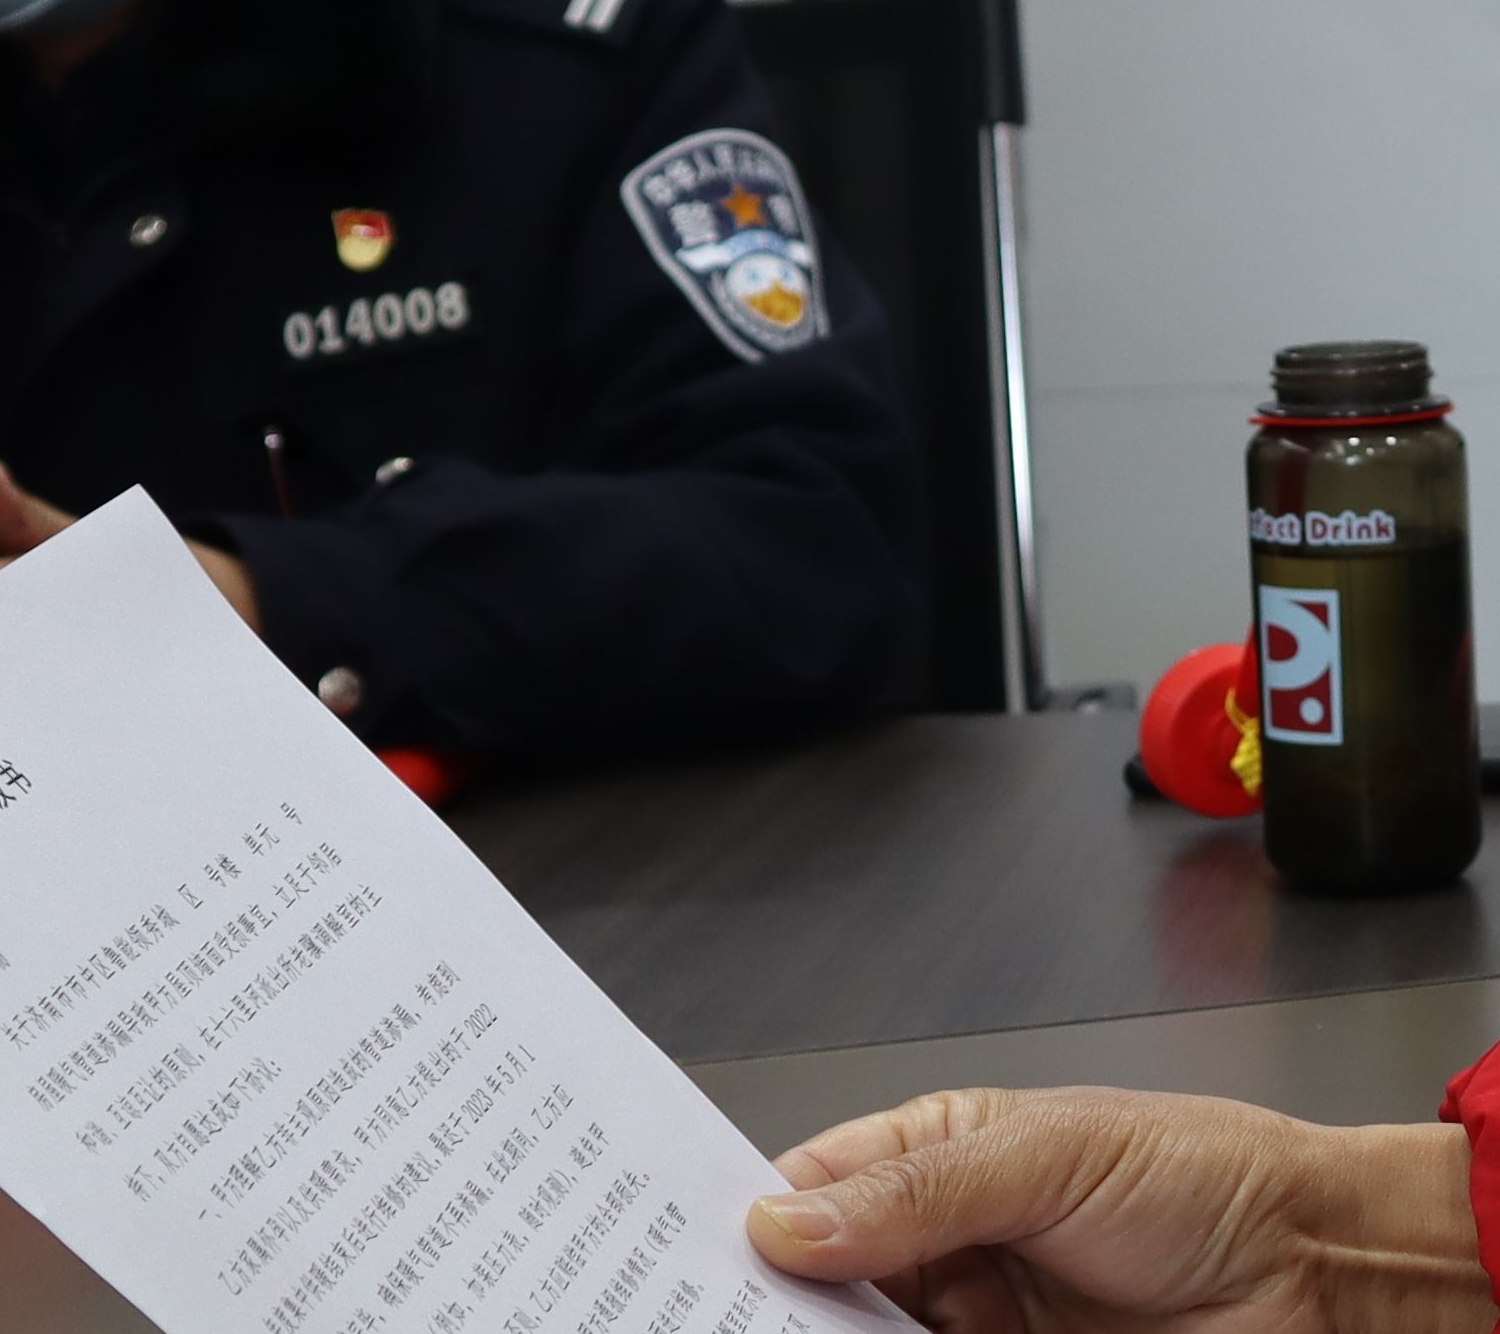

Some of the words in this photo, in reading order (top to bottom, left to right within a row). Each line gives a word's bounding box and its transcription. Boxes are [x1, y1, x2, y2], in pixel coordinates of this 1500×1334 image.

[284, 280, 472, 359] 014008
[1250, 510, 1300, 544] fect
[1307, 512, 1396, 544] Drink
